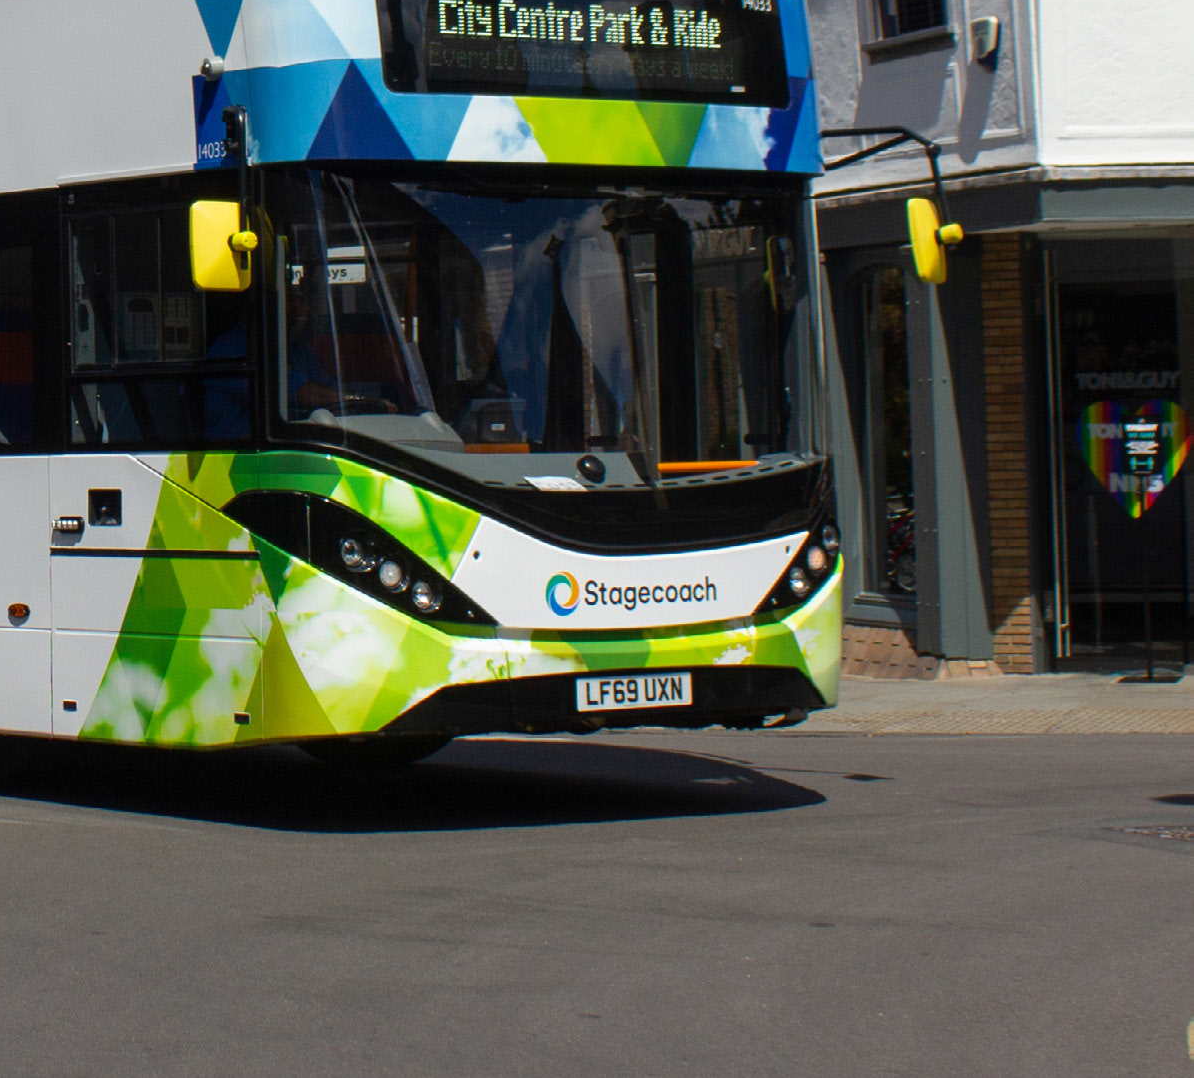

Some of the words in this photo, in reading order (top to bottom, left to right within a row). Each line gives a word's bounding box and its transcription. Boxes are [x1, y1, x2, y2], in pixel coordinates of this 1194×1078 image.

[499, 0, 584, 41] Centre
[589, 4, 645, 45] Park
[650, 8, 668, 45] &
[673, 9, 721, 48] Ride
[584, 576, 717, 610] Stagecoach
[586, 679, 639, 706] LF69
[644, 677, 683, 702] UXN
